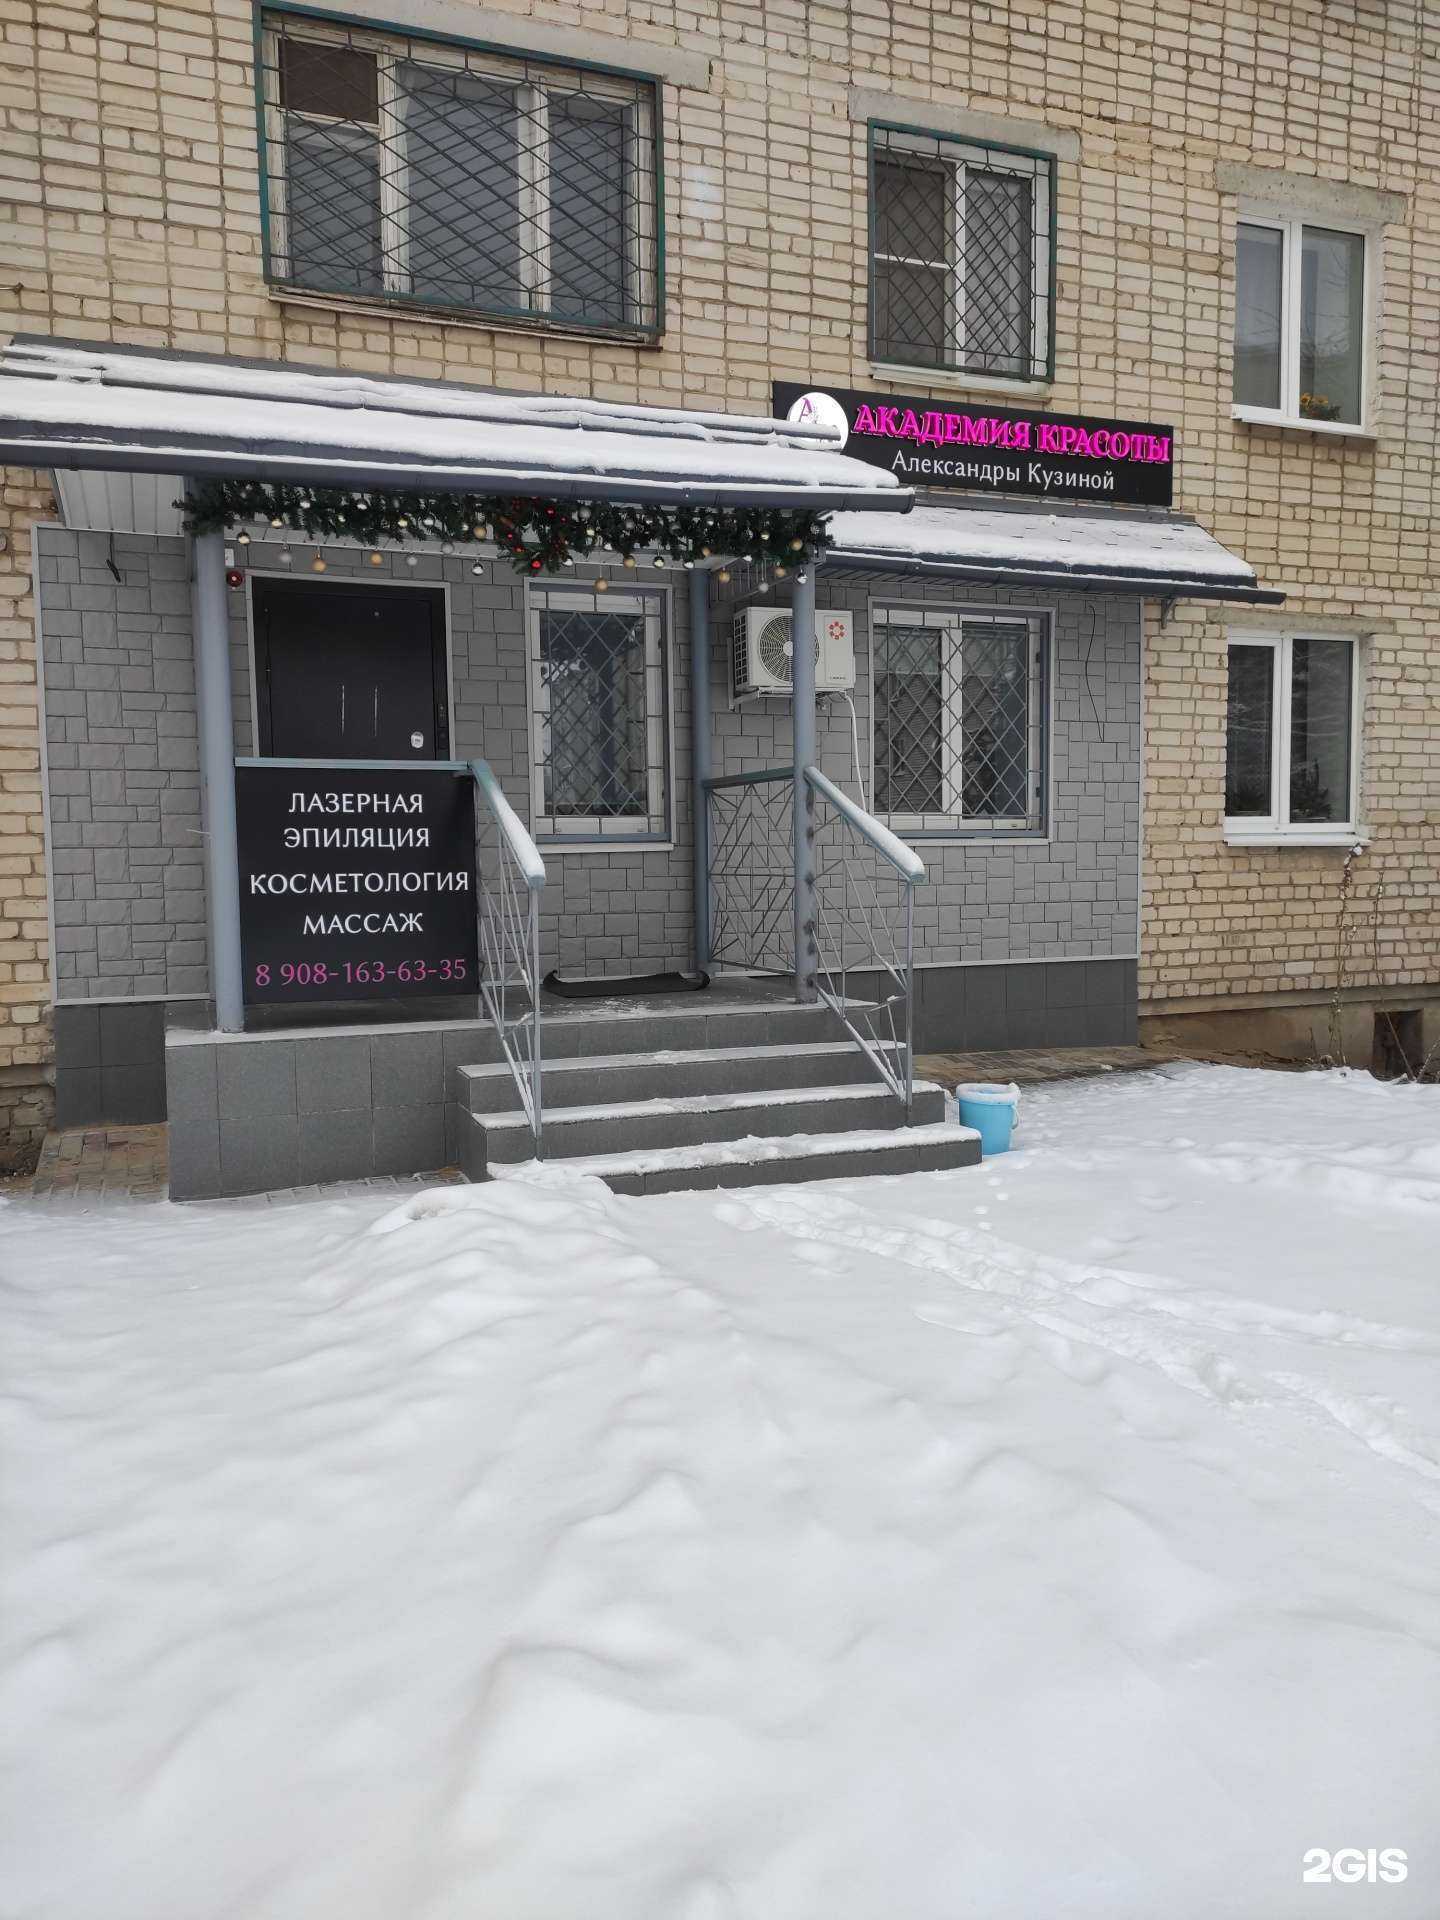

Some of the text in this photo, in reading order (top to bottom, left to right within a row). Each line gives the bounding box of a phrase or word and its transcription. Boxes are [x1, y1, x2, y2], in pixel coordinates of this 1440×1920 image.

[851, 404, 1172, 463] АКАДЕМИЯ КРАСОТЫ
[891, 449, 1115, 490] Александры Кузиной
[288, 792, 424, 814] ЛАЗЕРНАЯ
[283, 827, 430, 851] ЭПИЛЯЦИЯ
[249, 871, 469, 895] КОСМЕТОЛОГИЯ
[302, 912, 424, 936] МАССАЖ
[255, 958, 467, 987] 8 908-163-63-35
